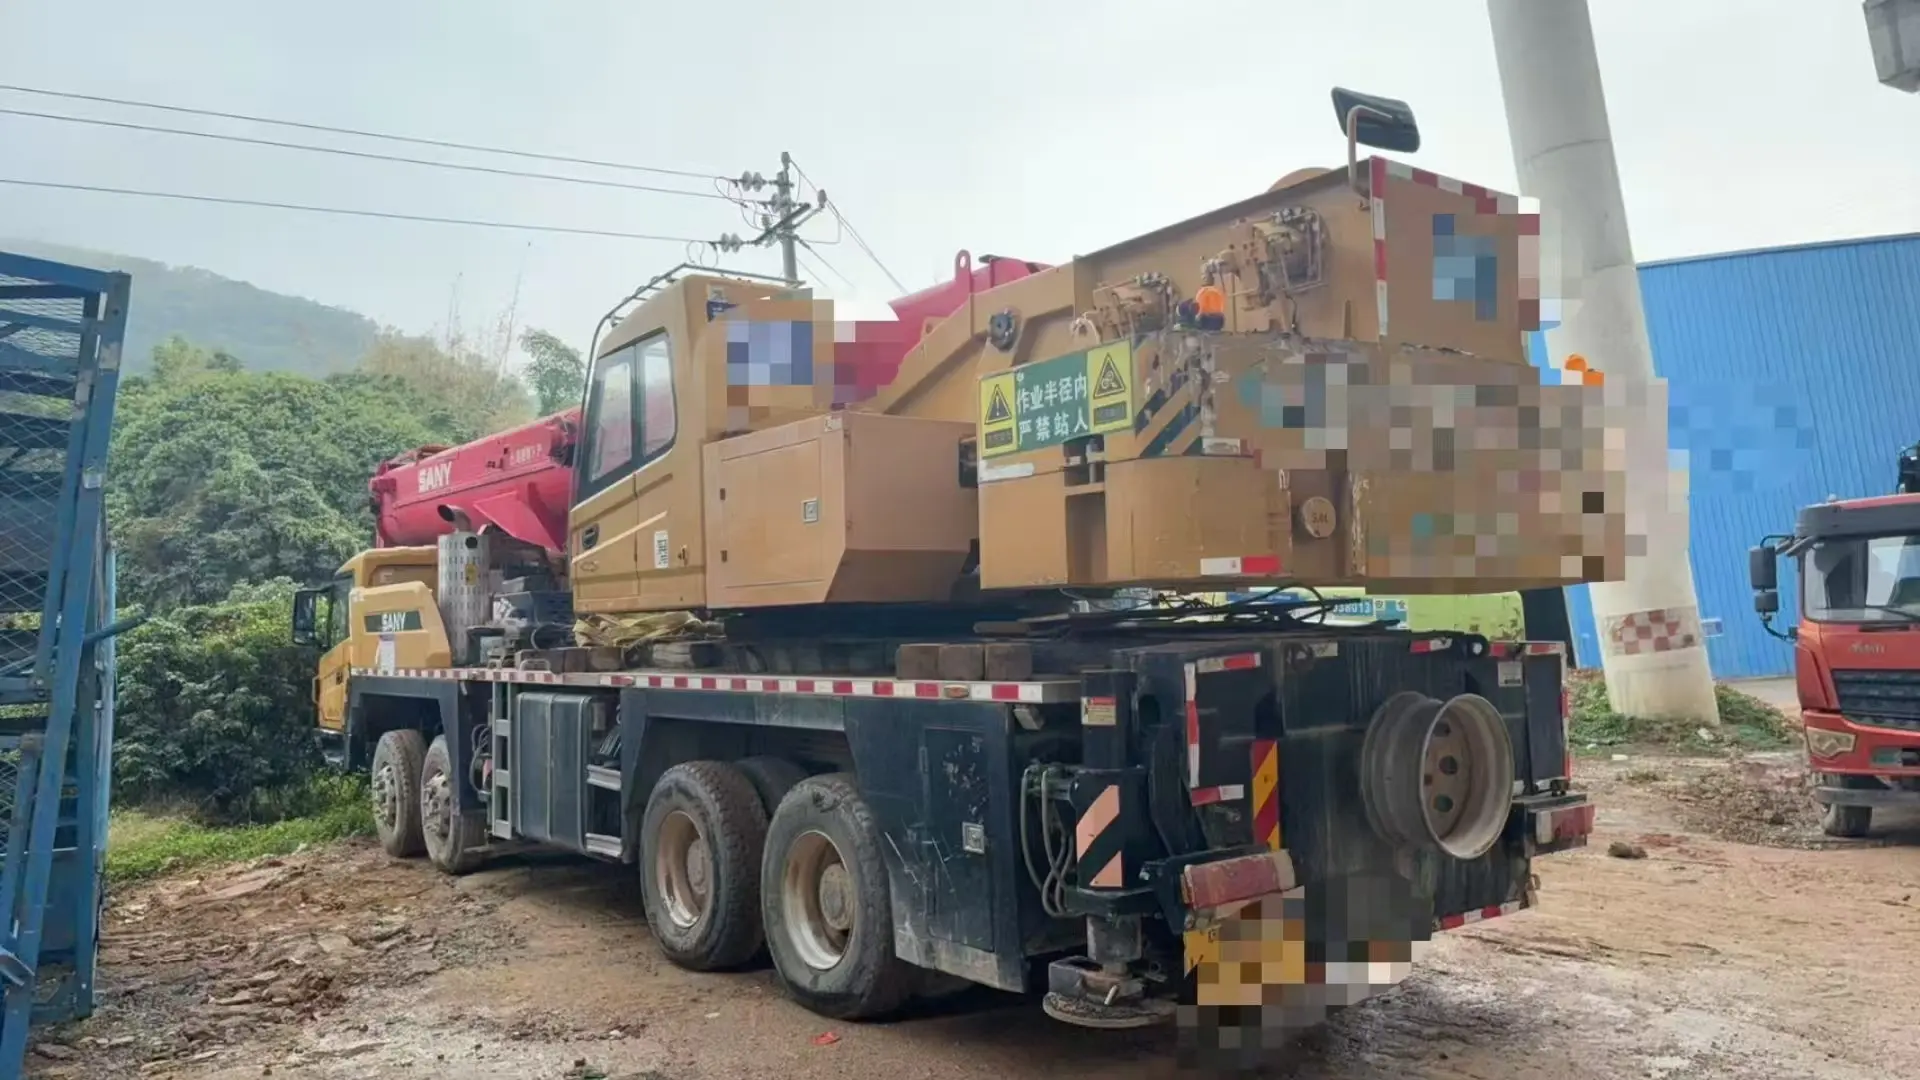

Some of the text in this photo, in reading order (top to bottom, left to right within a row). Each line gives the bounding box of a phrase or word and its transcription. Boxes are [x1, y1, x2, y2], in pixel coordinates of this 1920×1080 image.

[1016, 371, 1088, 414] 作业半径内
[1018, 406, 1088, 445] 严禁站人
[418, 461, 452, 493] SANY
[381, 611, 406, 632] SANY
